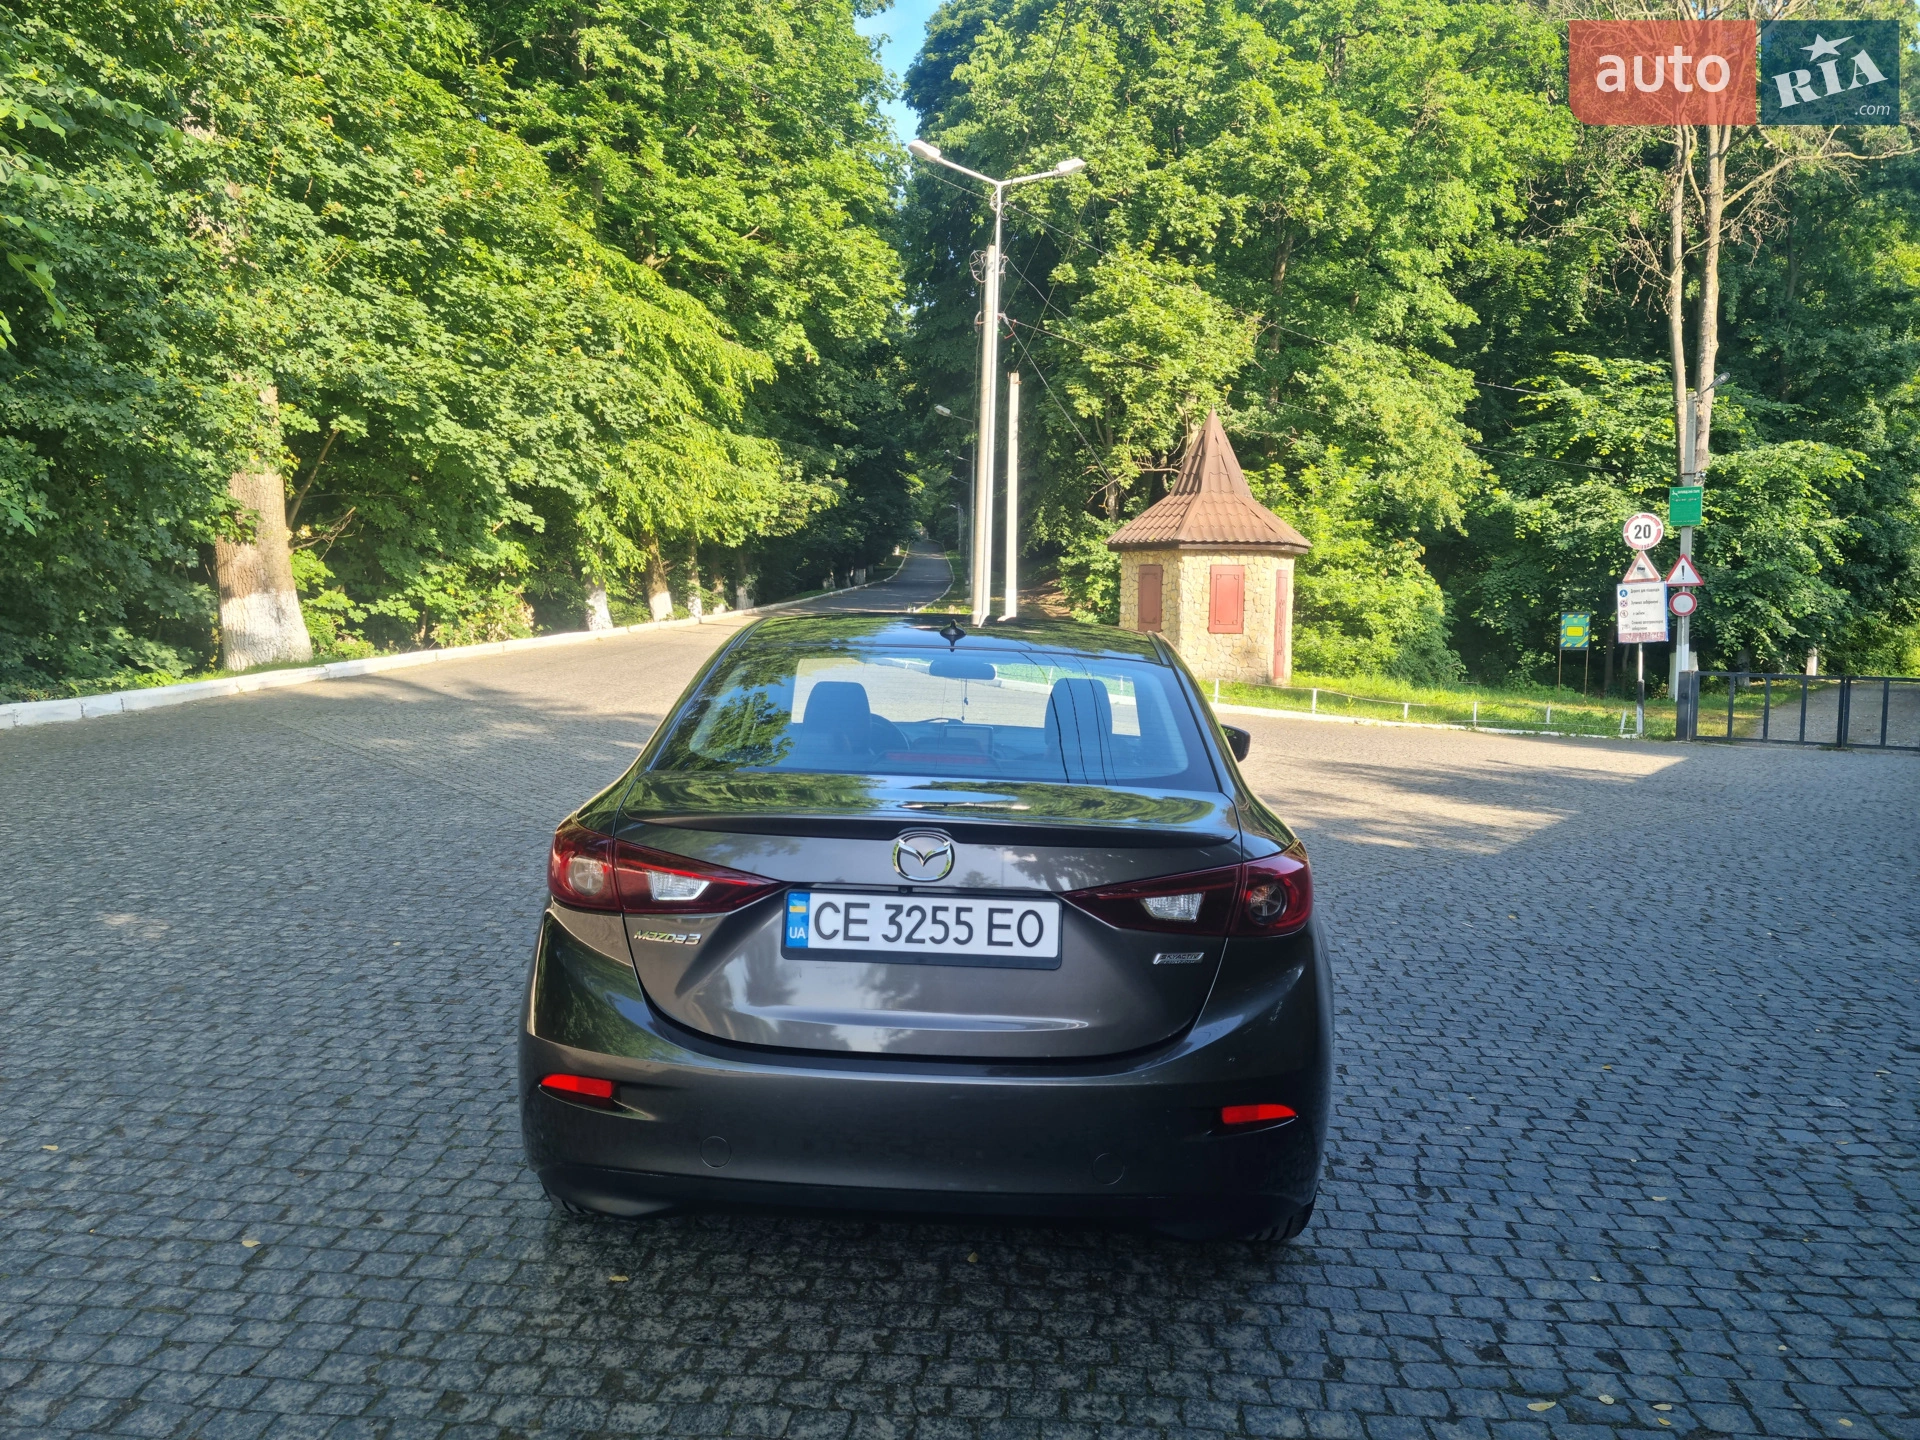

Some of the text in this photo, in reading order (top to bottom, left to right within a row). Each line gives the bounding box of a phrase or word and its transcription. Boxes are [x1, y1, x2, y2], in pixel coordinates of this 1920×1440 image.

[1634, 524, 1651, 539] 20
[814, 902, 1044, 948] CE 3255 EO
[789, 927, 806, 939] UA
